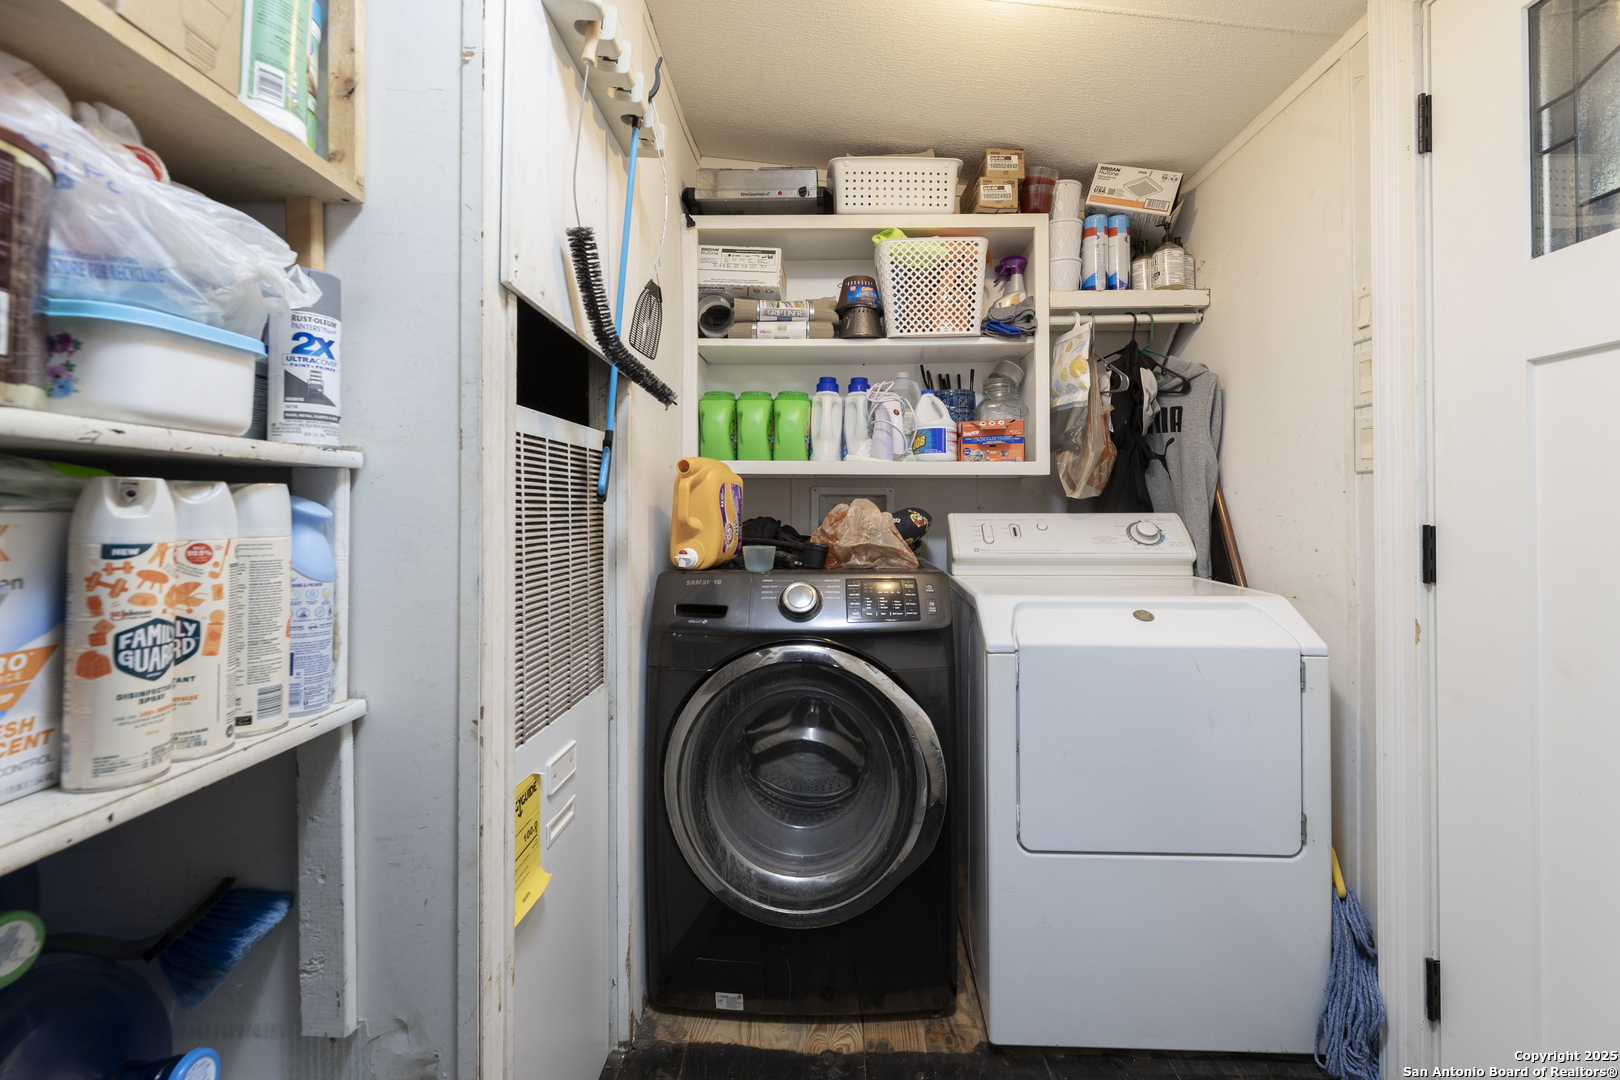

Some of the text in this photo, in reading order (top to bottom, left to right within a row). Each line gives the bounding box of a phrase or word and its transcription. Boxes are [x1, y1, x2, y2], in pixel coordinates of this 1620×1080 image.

[291, 332, 335, 360] 2X
[111, 548, 140, 556] NEW
[138, 693, 165, 705] SPRAY
